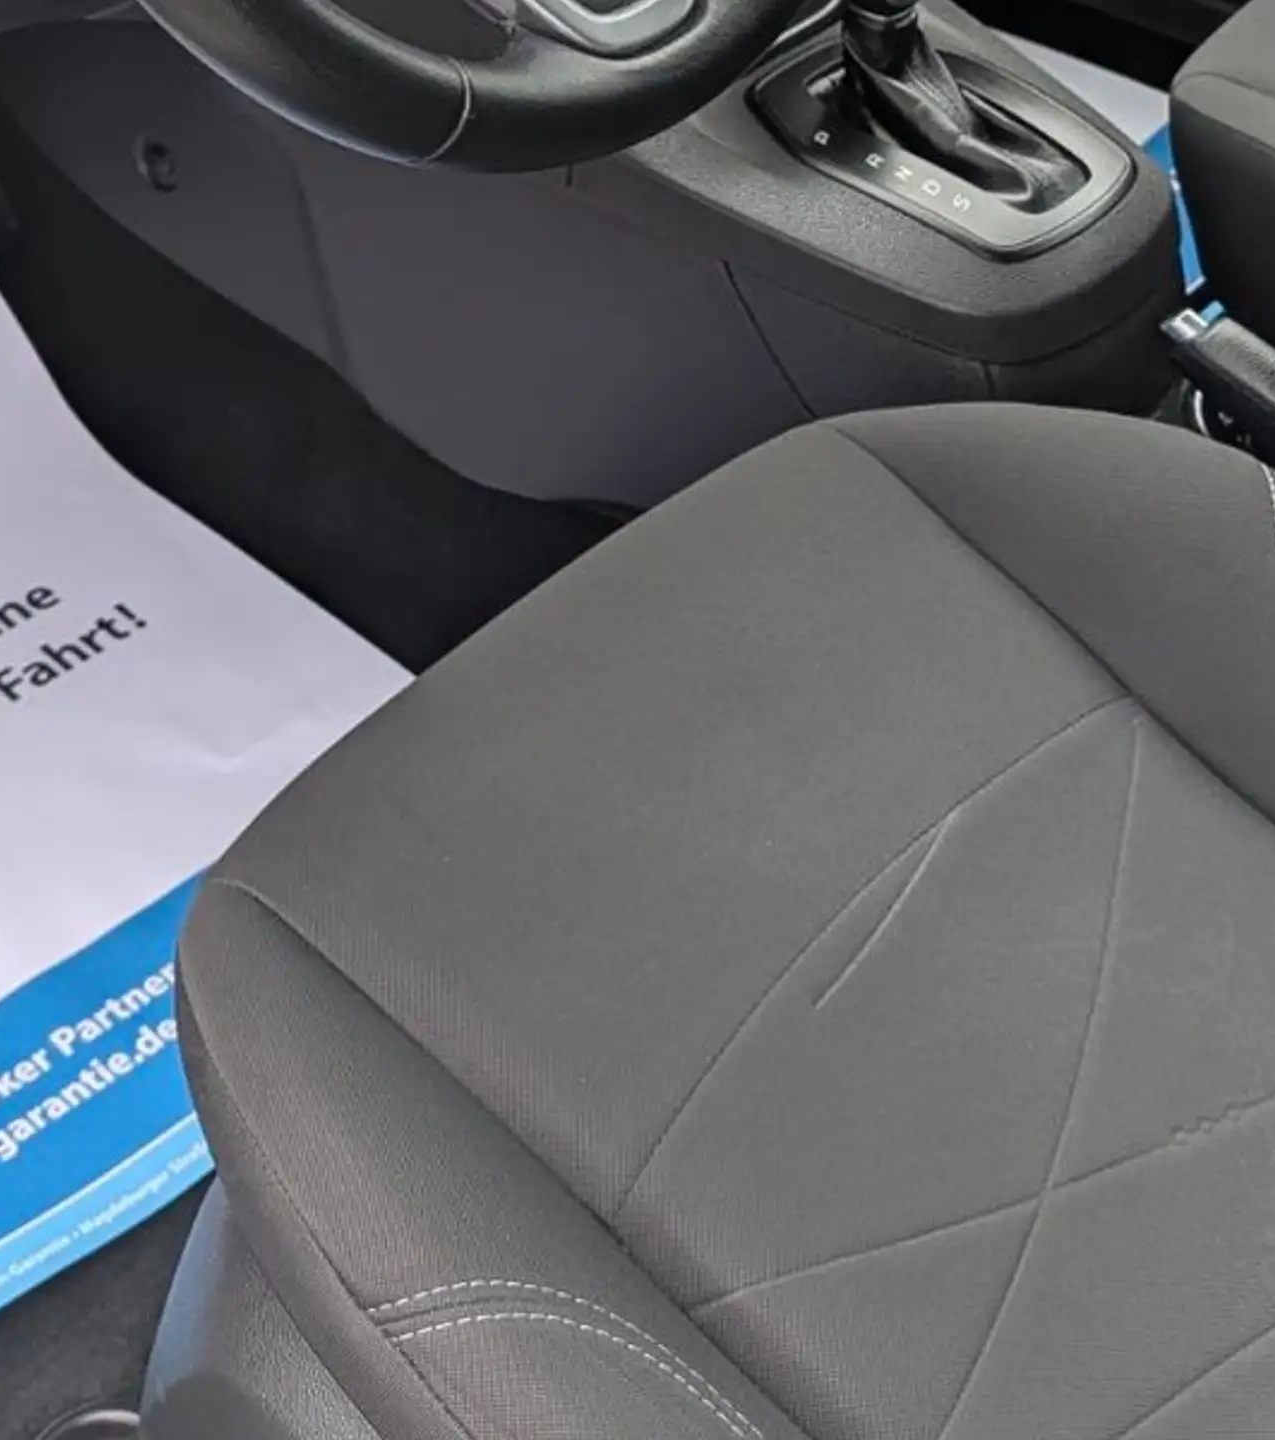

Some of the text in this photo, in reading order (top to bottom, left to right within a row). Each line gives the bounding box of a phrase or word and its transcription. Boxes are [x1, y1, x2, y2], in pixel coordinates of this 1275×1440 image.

[865, 152, 886, 170] R
[893, 164, 914, 182] N
[921, 178, 941, 197] D
[952, 192, 972, 212] S
[49, 961, 175, 1057] Partner
